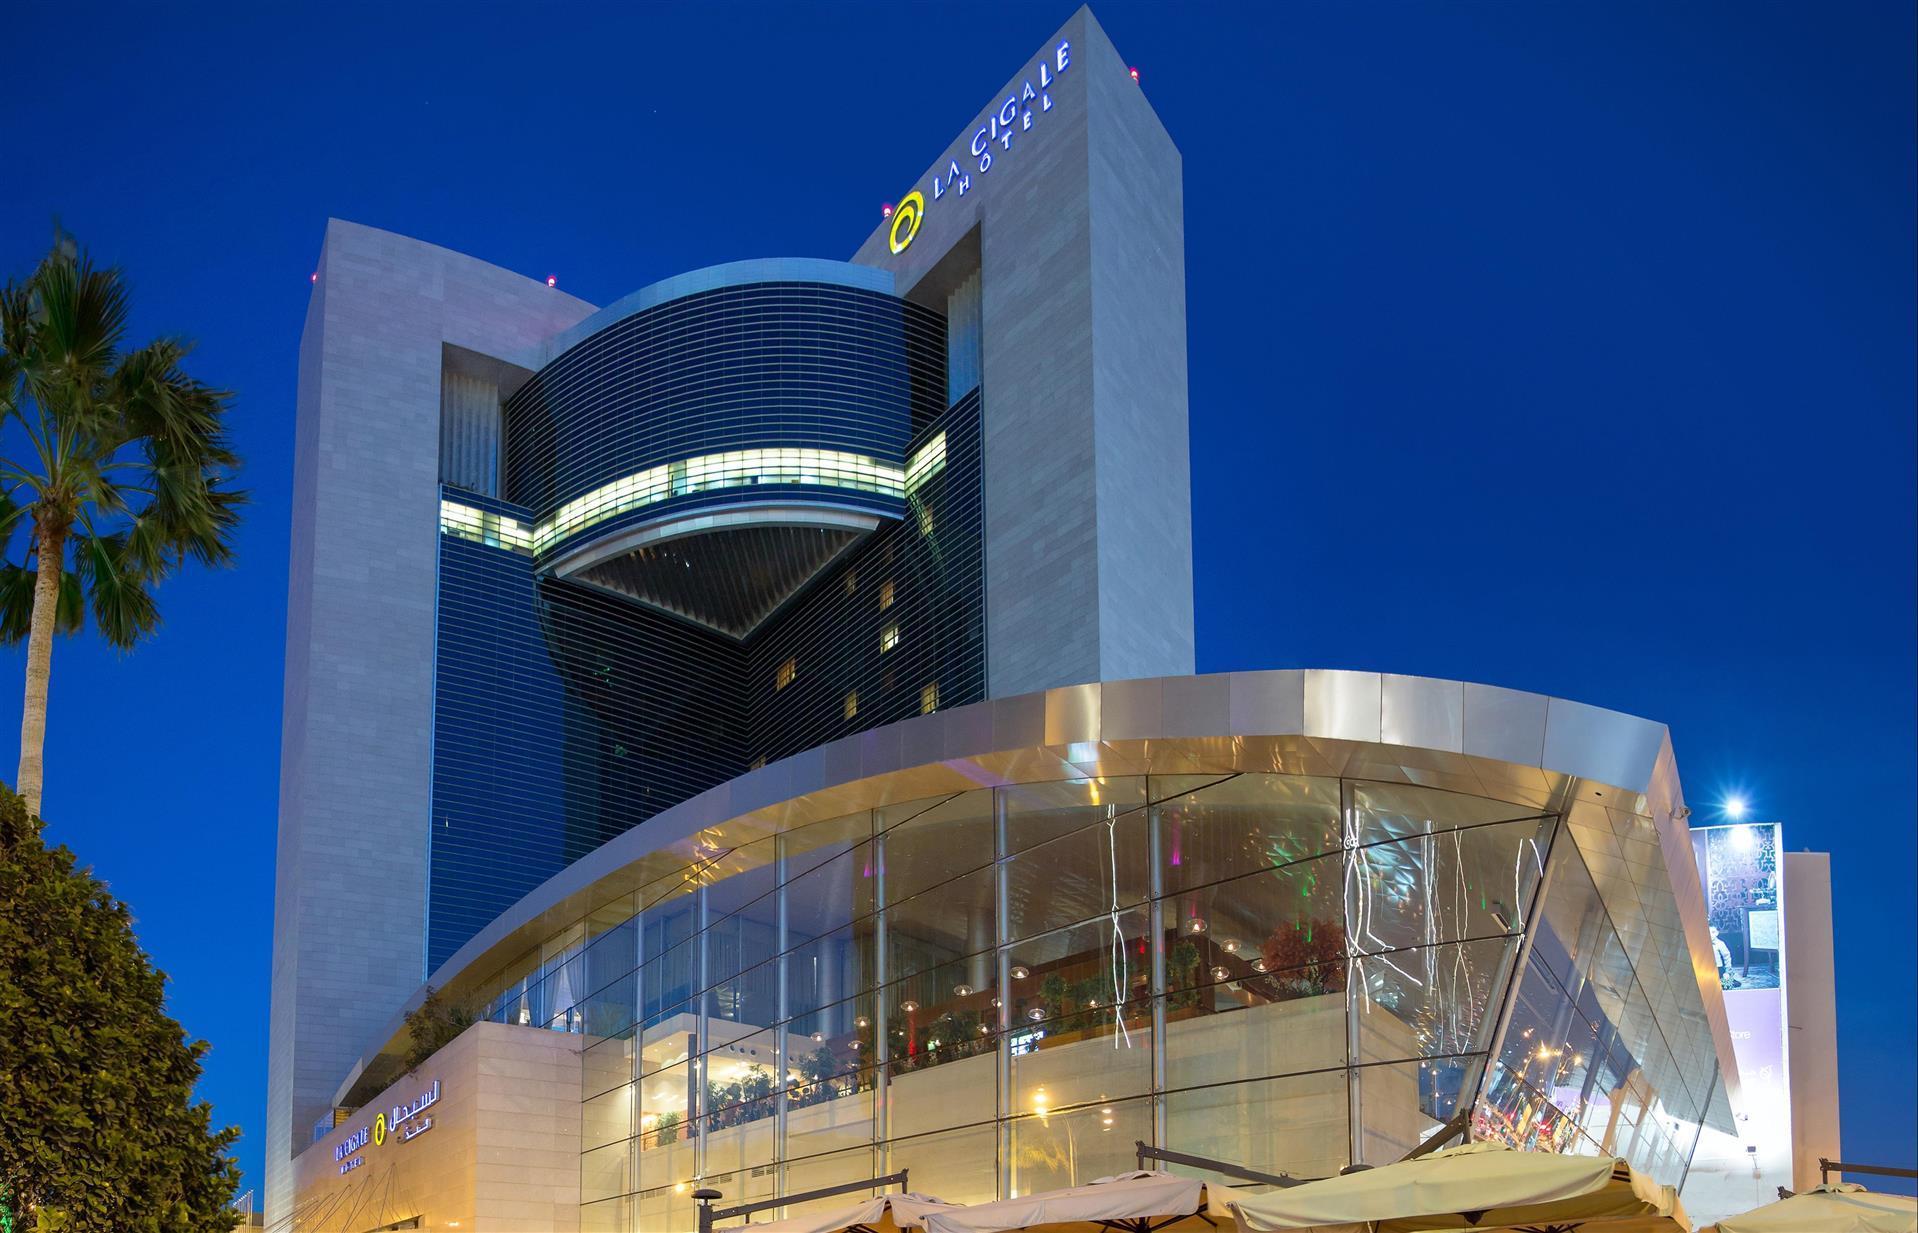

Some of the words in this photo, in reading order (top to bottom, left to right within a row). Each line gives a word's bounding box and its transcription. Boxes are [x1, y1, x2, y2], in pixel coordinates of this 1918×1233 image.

[934, 160, 961, 199] LA
[971, 41, 1070, 156] CIGALE
[344, 1126, 368, 1156] CIGALE
